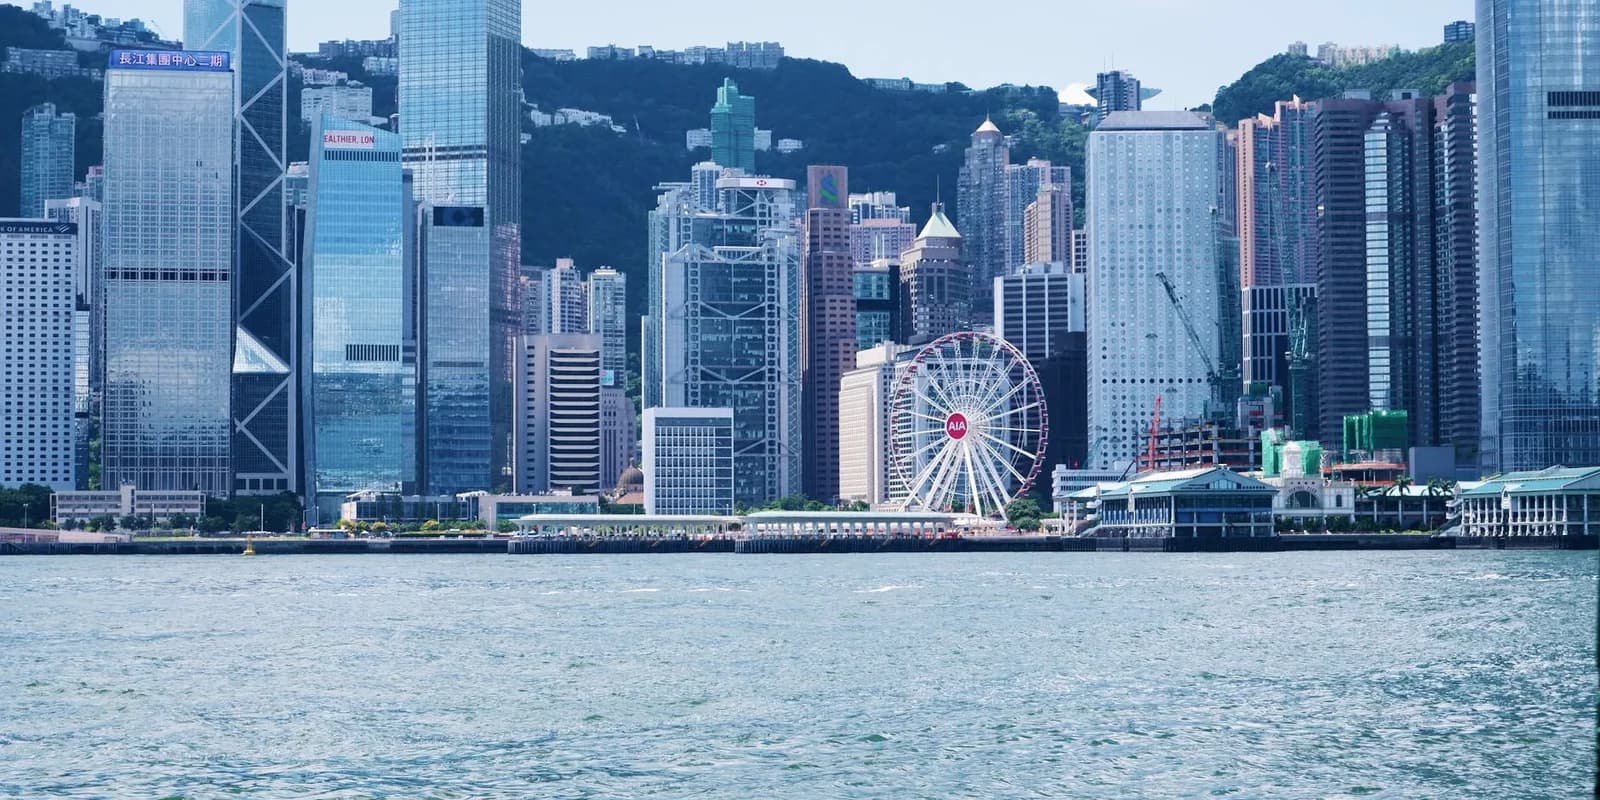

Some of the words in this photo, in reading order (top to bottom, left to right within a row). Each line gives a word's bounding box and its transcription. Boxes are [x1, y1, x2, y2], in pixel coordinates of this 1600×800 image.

[120, 52, 223, 67] 長江集團中心二期
[949, 421, 966, 431] AIA
